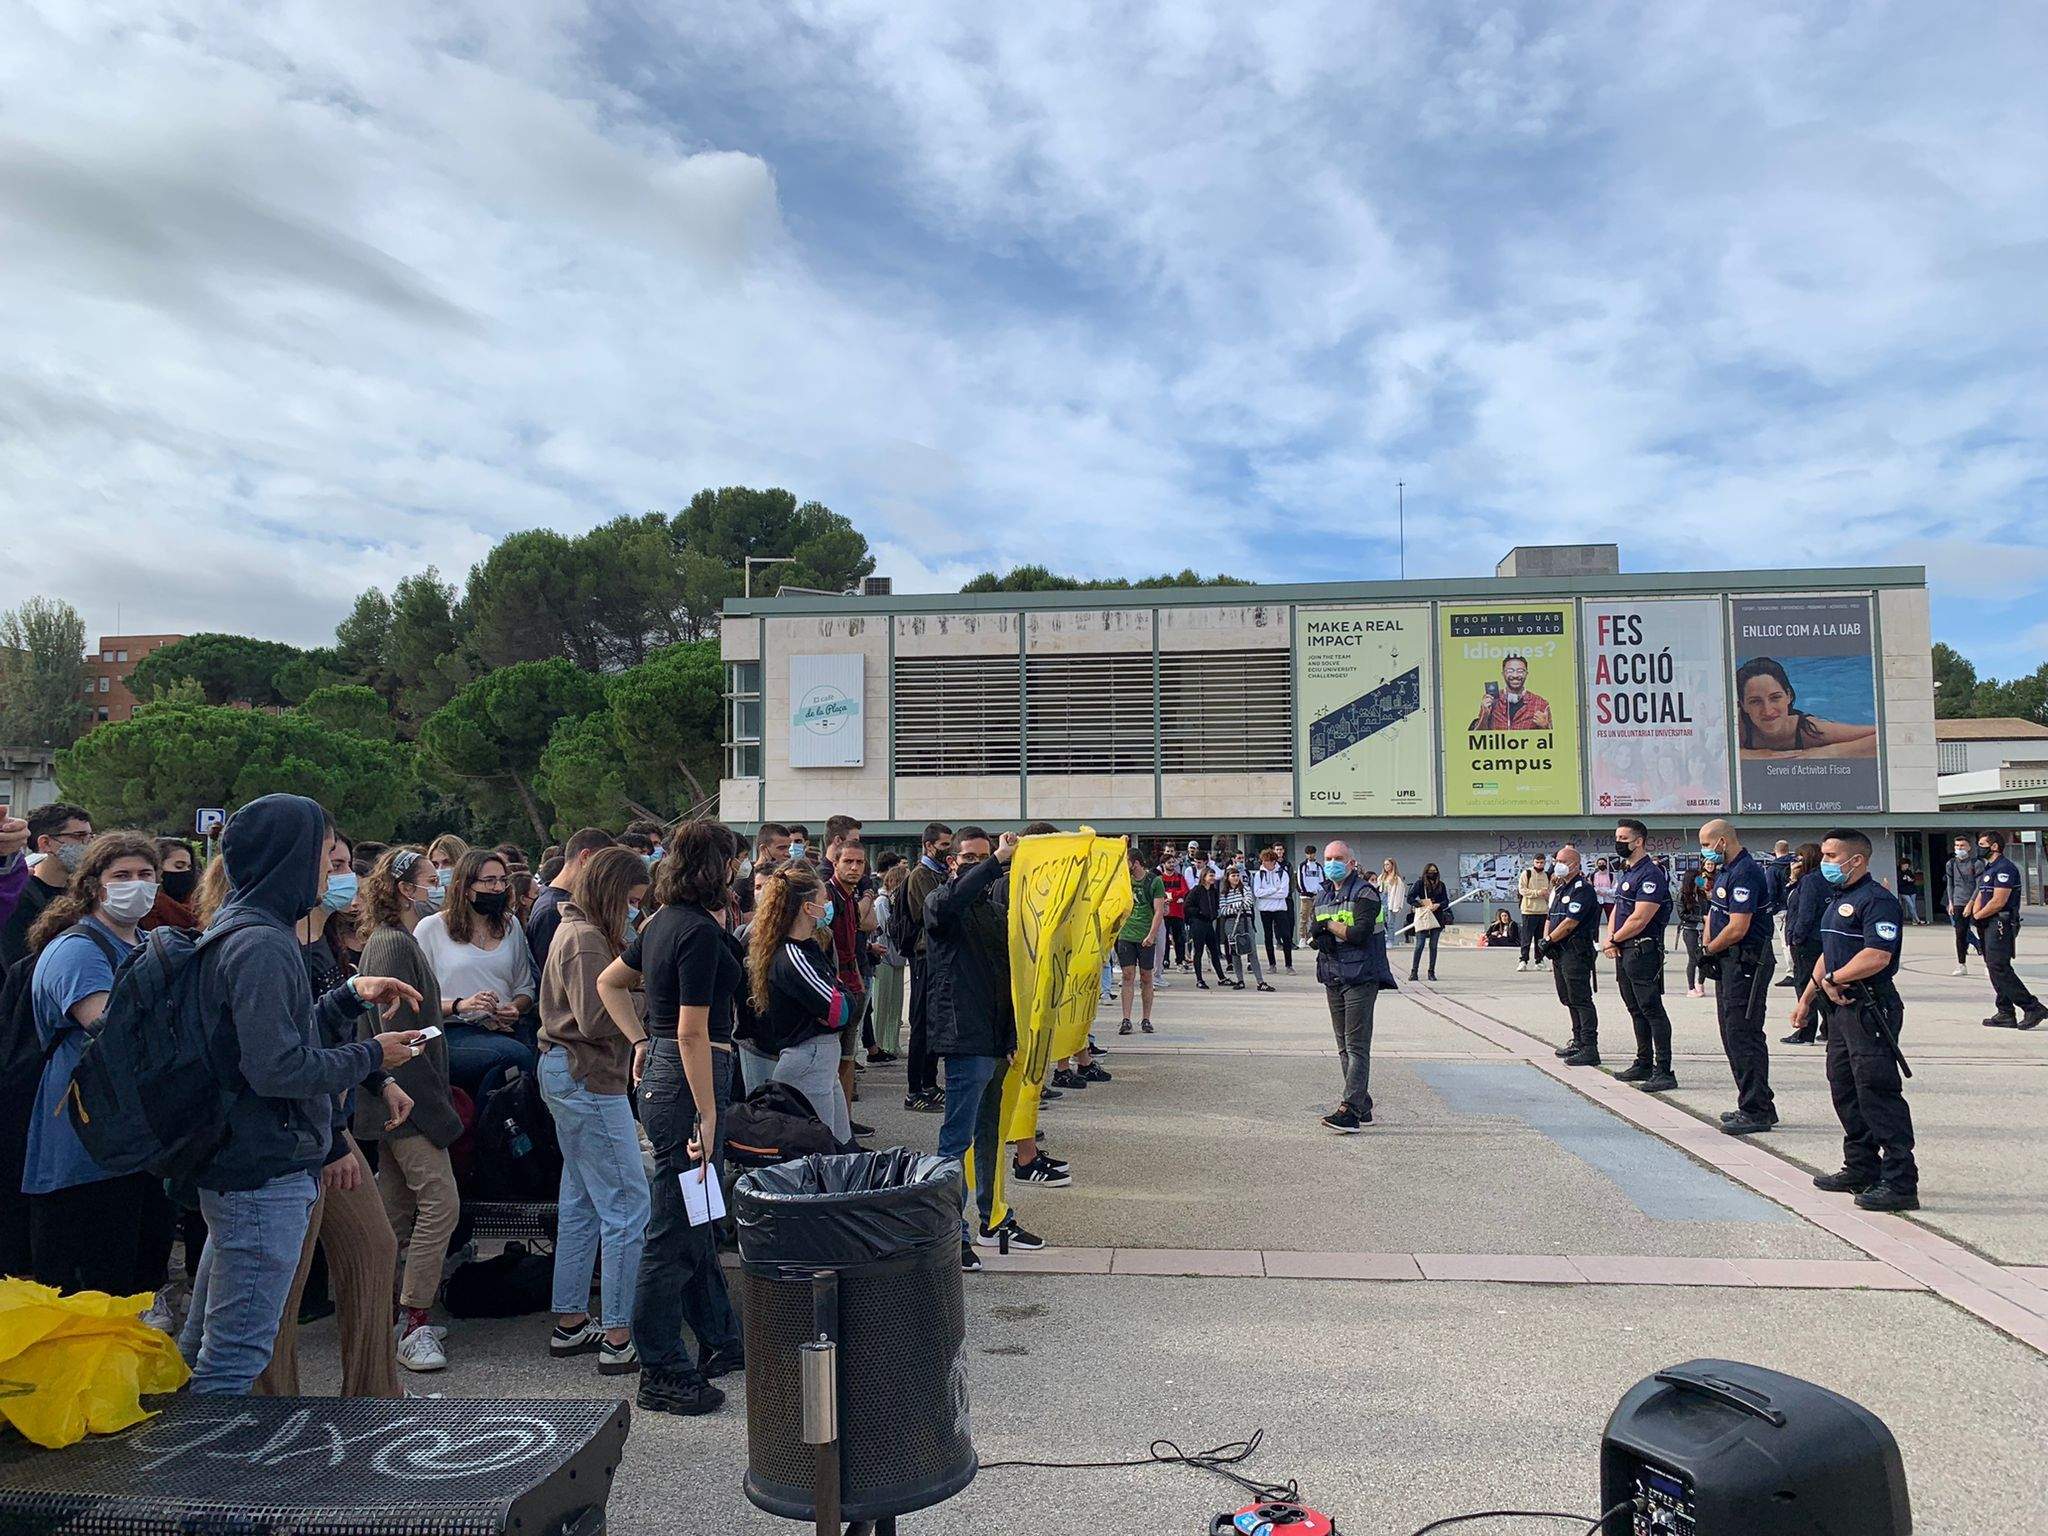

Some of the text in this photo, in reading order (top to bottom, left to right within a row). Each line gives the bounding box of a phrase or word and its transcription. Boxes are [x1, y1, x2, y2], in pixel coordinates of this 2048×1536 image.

[1308, 620, 1404, 632] MAKE A REAL
[1482, 626, 1504, 634] THE
[1516, 625, 1560, 633] WORLD
[1597, 614, 1643, 646] FES
[1743, 623, 1861, 637] ENLLOC COM A LA UAB
[1308, 635, 1363, 646] IMPACT
[1463, 641, 1556, 659] Idiomes?
[1595, 646, 1673, 685] ACCIÓ
[805, 703, 847, 718] de la Plaça
[1596, 692, 1693, 724] SOCIAL
[1597, 728, 1693, 738] FES UN VOLUNTARIAT UNIVERSITARI
[1469, 733, 1553, 750] Millor al
[1472, 759, 1552, 774] campus
[1767, 764, 1851, 775] Servei d'Activitat Física
[1310, 791, 1341, 800] ECIU
[1780, 801, 1841, 811] MOVEM EL CAMPUS
